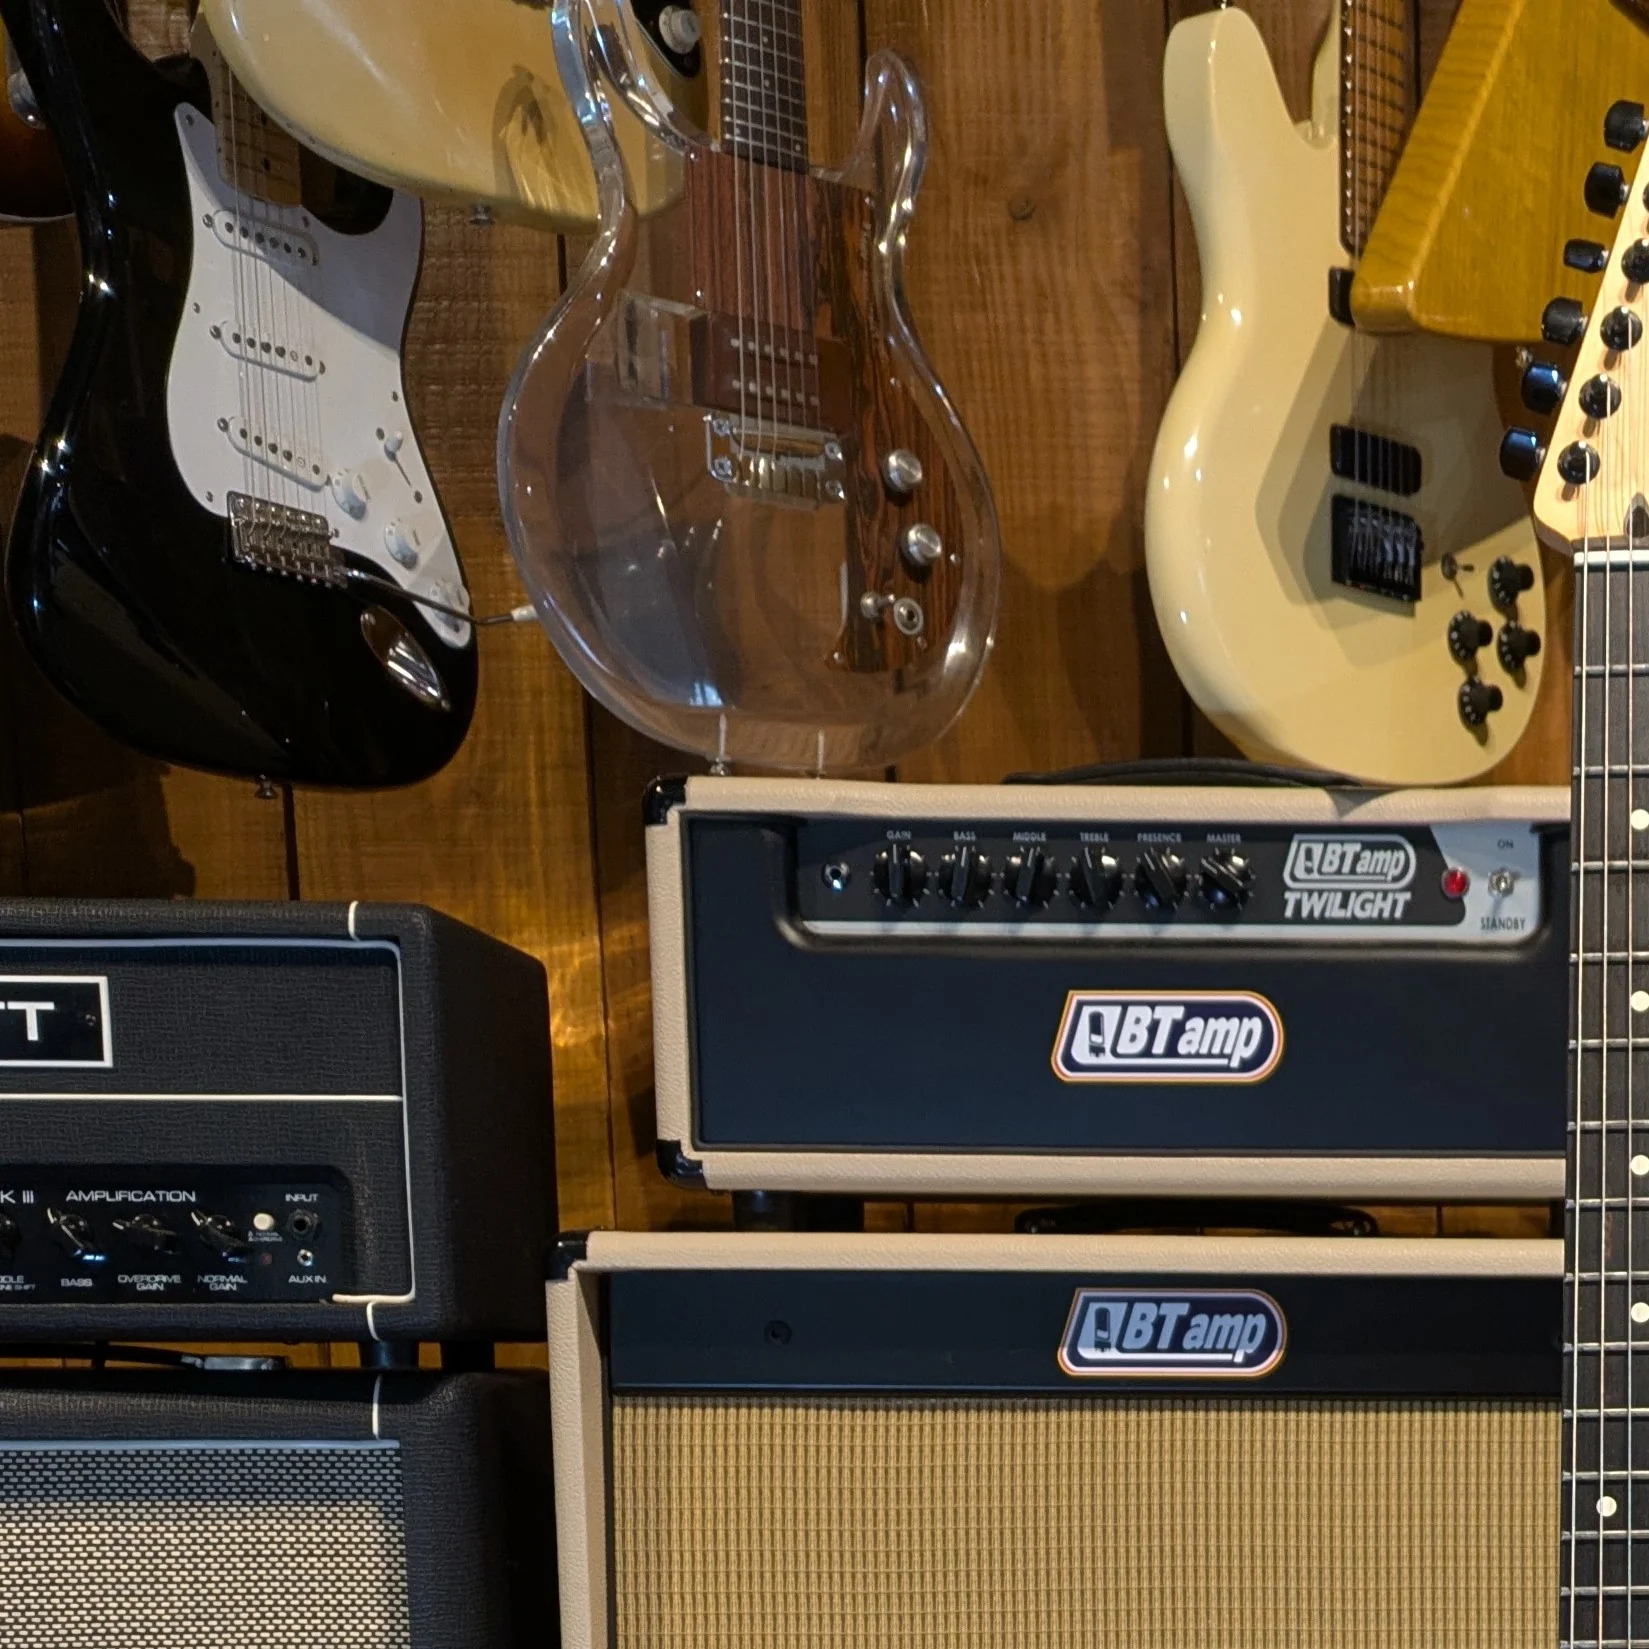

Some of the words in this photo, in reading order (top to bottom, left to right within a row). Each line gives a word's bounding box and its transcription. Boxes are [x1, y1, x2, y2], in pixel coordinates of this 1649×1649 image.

[886, 830, 912, 841] GAIN
[953, 831, 976, 842] BASS
[1012, 832, 1047, 843] MIDDLE
[1080, 832, 1110, 843] TREBLE
[1137, 832, 1183, 843] PRESENCE
[1206, 832, 1242, 844] MASTER
[1497, 838, 1514, 850] ON
[1284, 890, 1412, 919] TWILIGHT
[1480, 916, 1526, 933] STANDBY
[0, 1001, 55, 1041] T
[22, 1190, 34, 1204] III
[66, 1190, 196, 1203] AMPLIFICATION
[285, 1193, 319, 1203] INPUT
[61, 1278, 93, 1288] BASS
[118, 1274, 182, 1285] OVERDRIVE
[197, 1275, 249, 1285] NORMAL
[288, 1275, 313, 1284] AUX
[314, 1275, 328, 1284] IN
[136, 1283, 165, 1293] GAIN
[209, 1283, 238, 1292] GAIN
